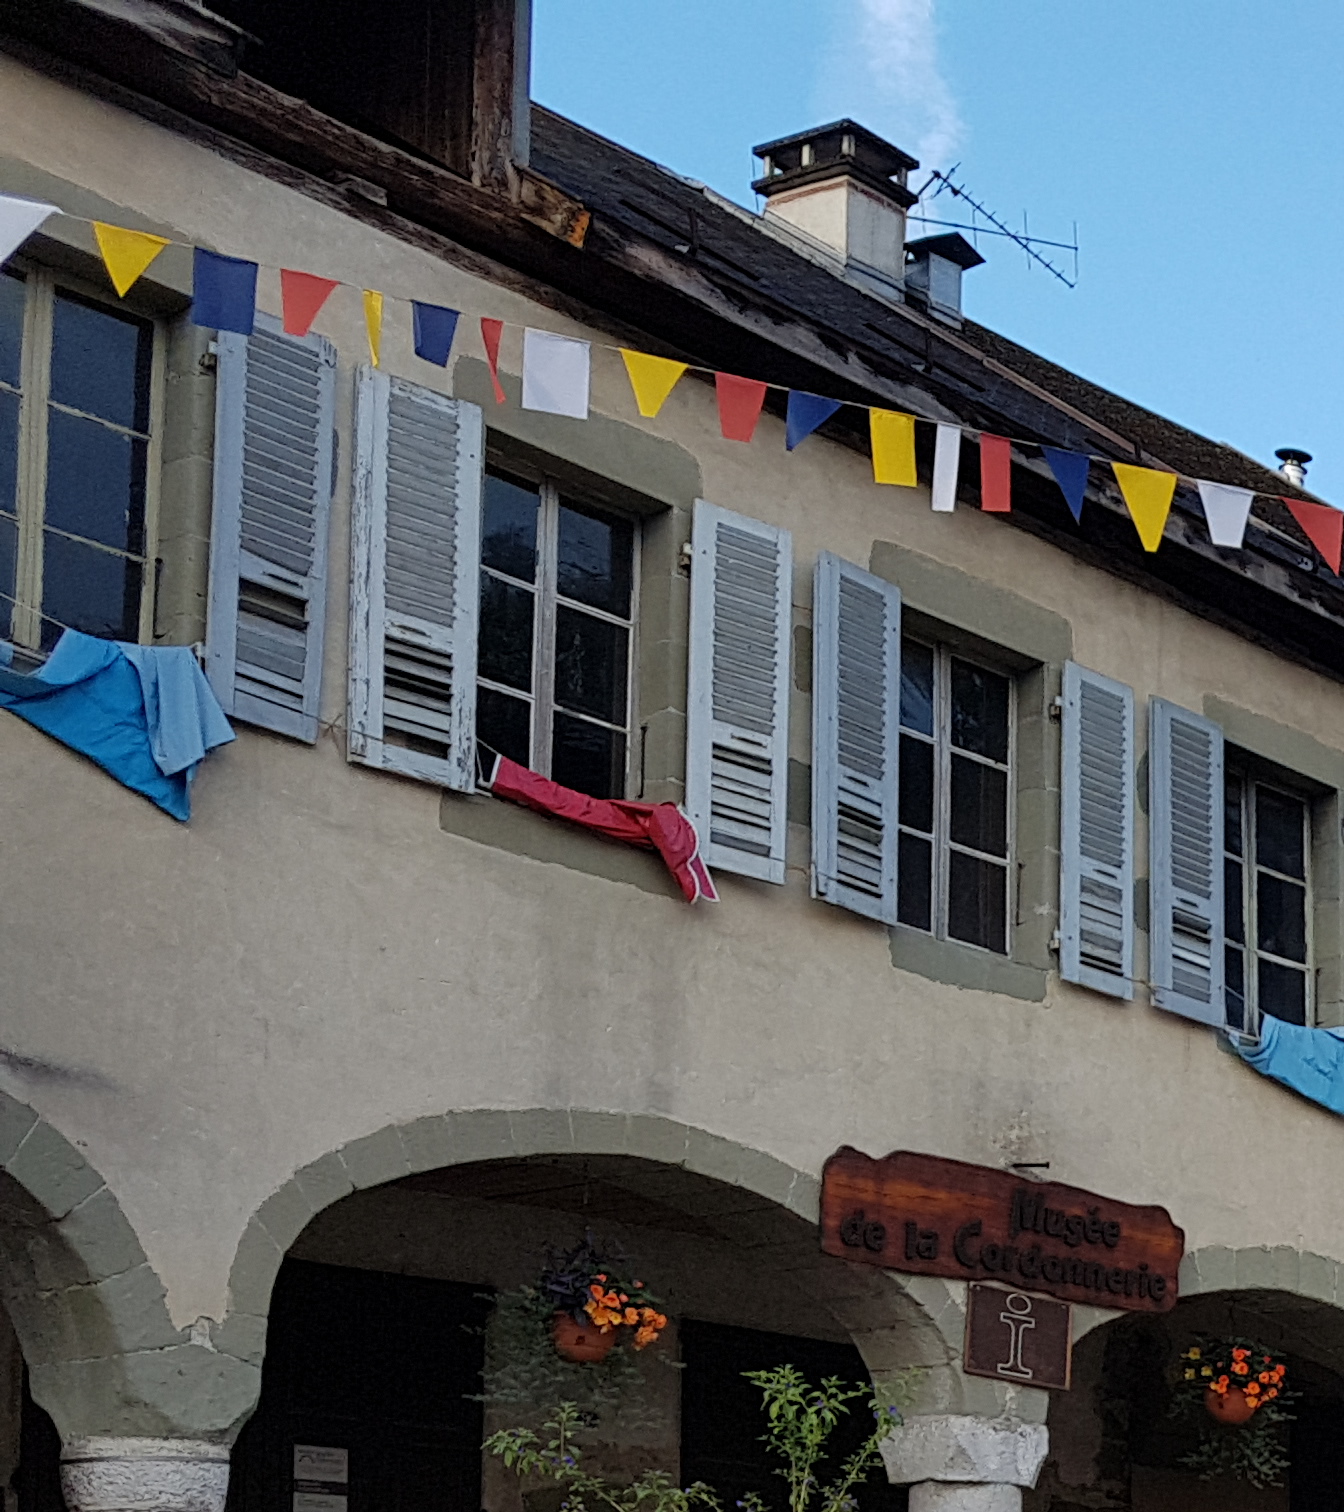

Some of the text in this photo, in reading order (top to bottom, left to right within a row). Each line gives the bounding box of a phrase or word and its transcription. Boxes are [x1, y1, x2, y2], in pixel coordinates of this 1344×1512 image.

[840, 1210, 1169, 1301] de la Cordonnerie
[1011, 1189, 1121, 1249] Musée
